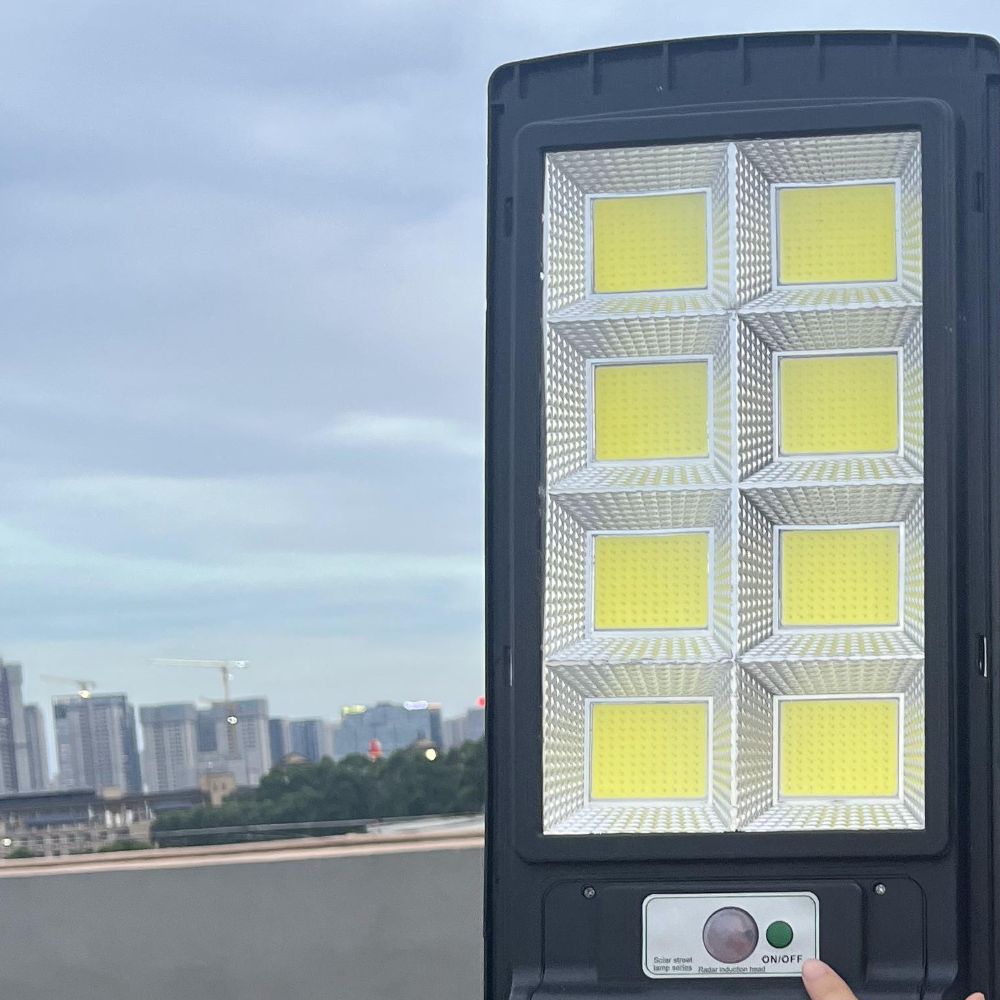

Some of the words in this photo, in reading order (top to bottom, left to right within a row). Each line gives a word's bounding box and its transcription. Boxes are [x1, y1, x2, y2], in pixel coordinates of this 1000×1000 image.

[653, 956, 671, 964] Solar
[762, 954, 803, 964] ON/OFF
[653, 964, 670, 972] lamp
[749, 965, 766, 973] head
